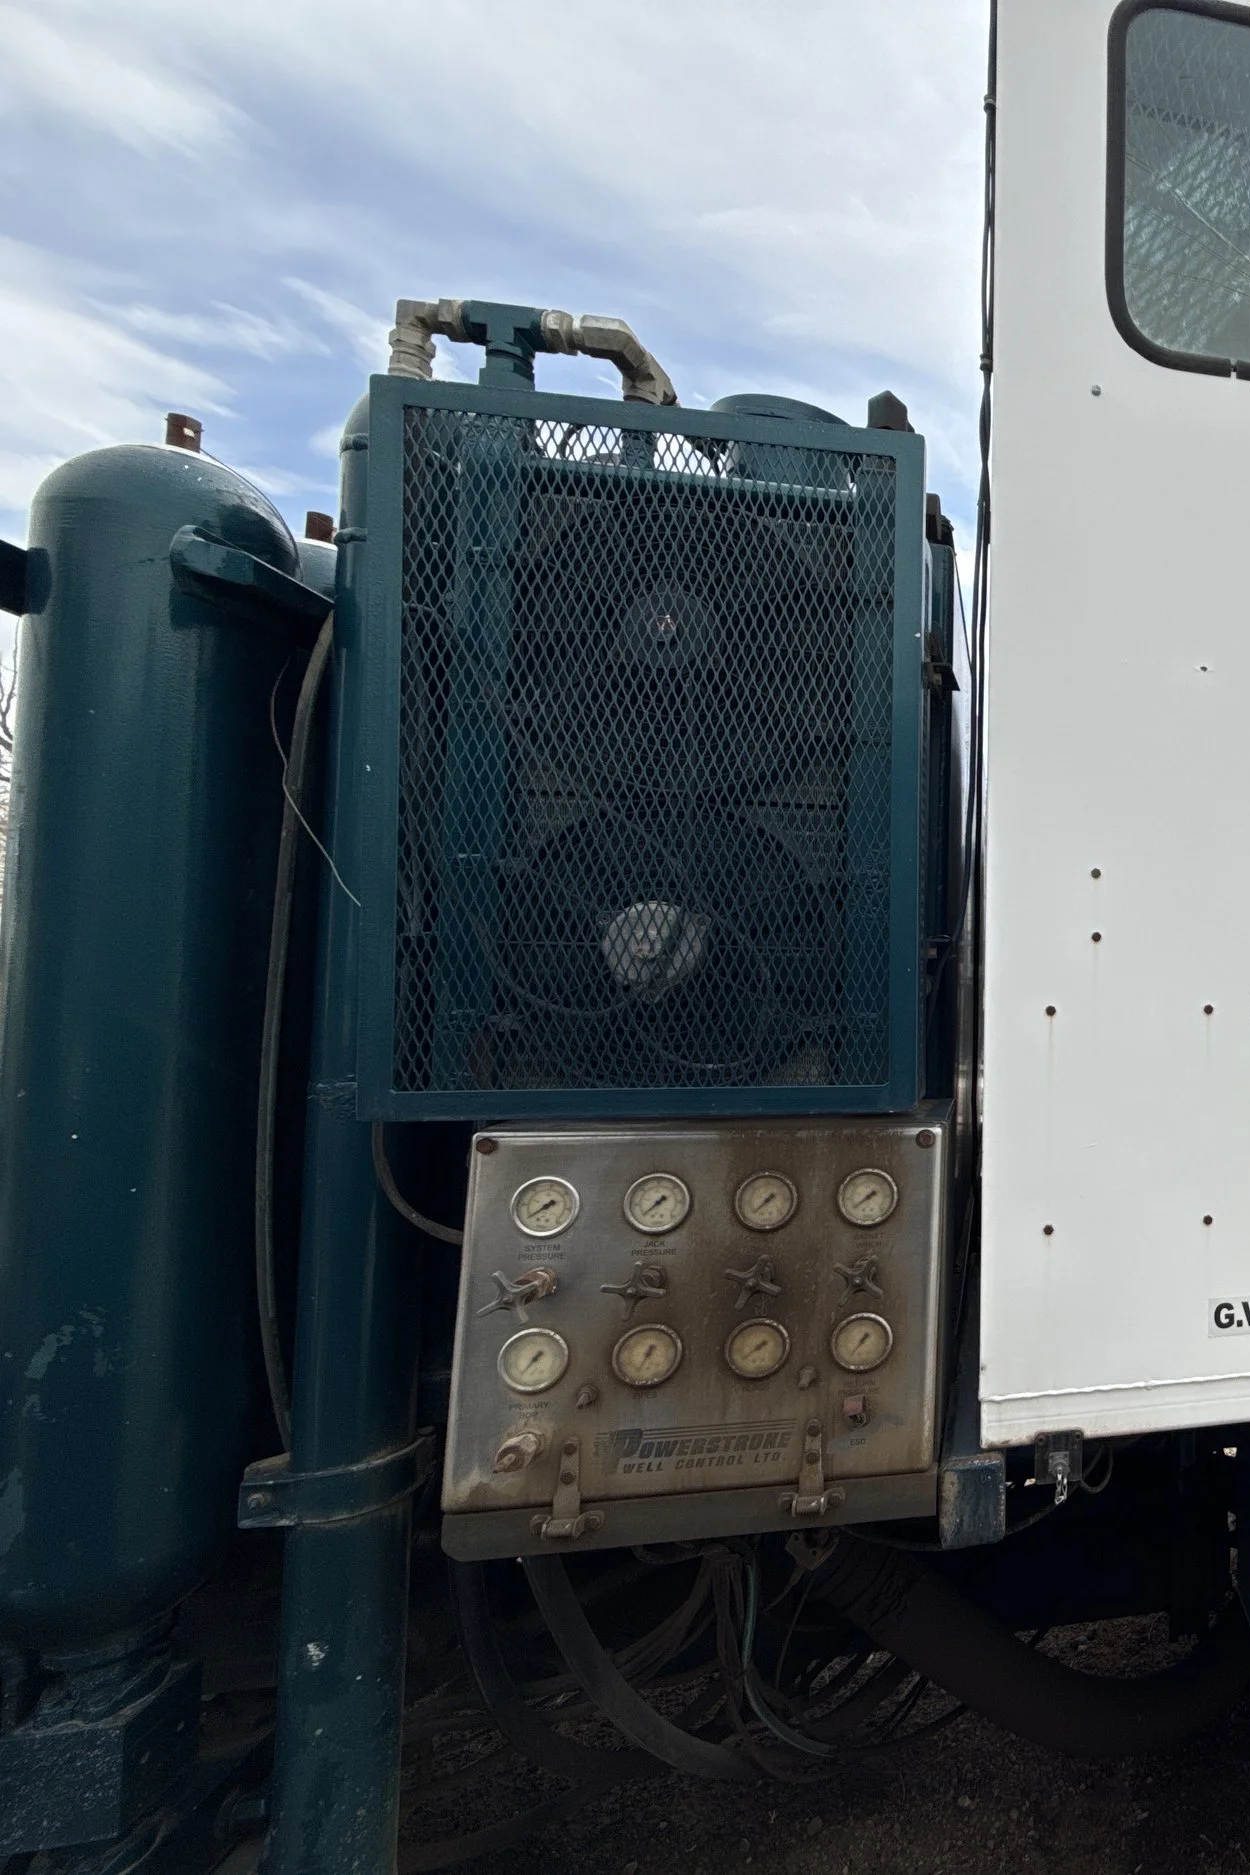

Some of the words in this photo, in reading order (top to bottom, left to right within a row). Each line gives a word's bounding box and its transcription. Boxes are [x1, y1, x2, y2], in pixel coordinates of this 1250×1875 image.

[524, 1243, 561, 1251] SYSTEM
[644, 1240, 665, 1248] JACK
[517, 1252, 566, 1261] PRESSURE
[631, 1248, 677, 1257] PRESSURE
[605, 1428, 793, 1475] POWERSTROKE
[622, 1462, 664, 1475] WELL
[675, 1454, 744, 1470] CONTROL
